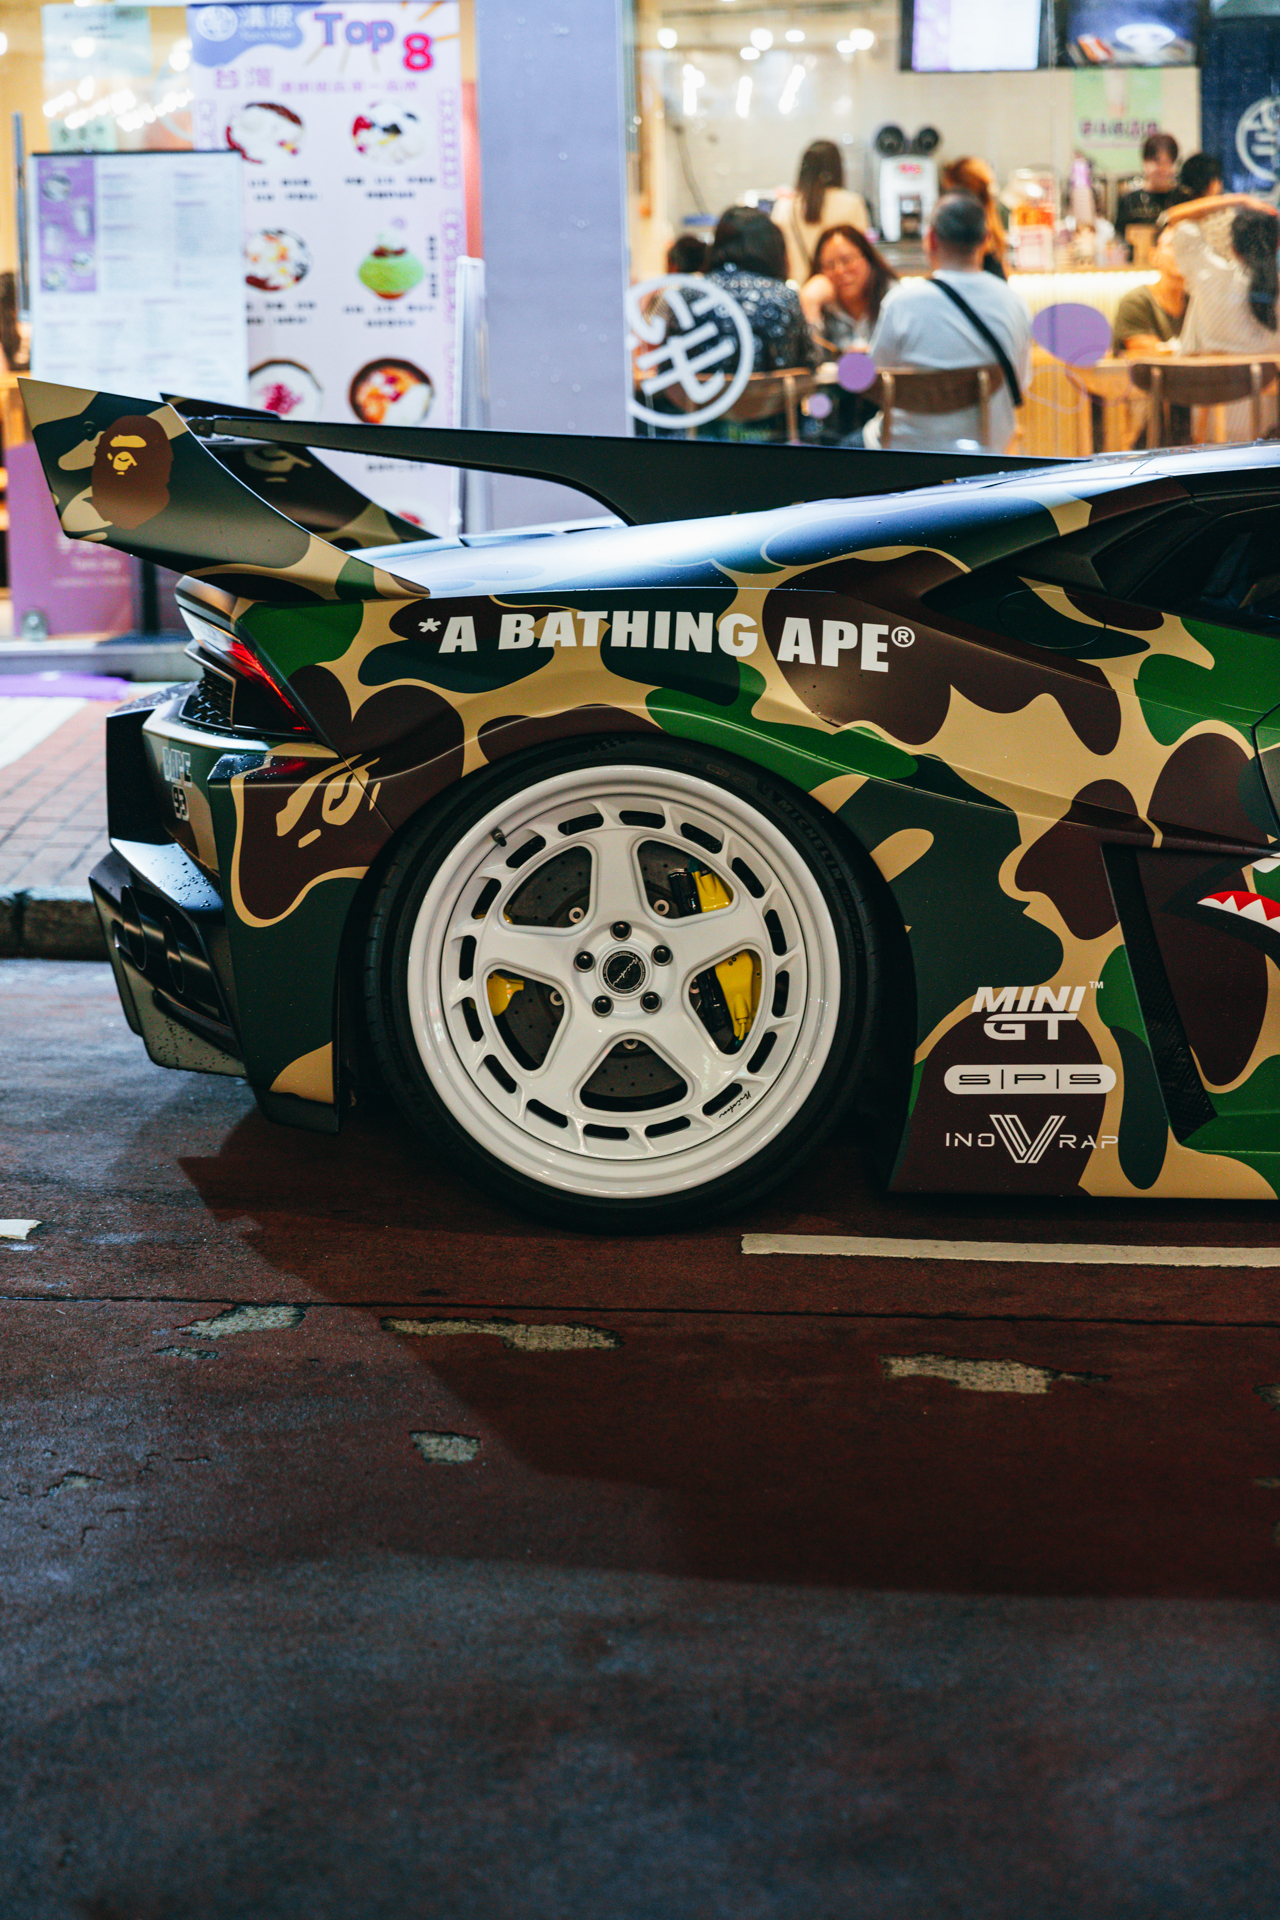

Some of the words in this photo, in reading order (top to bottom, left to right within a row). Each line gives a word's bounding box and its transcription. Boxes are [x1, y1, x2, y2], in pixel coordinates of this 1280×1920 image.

[314, 12, 394, 53] Top
[402, 32, 434, 72] 8
[498, 610, 759, 657] BATHING
[778, 799, 842, 880] MICHELIN
[983, 1013, 1078, 1041] GT
